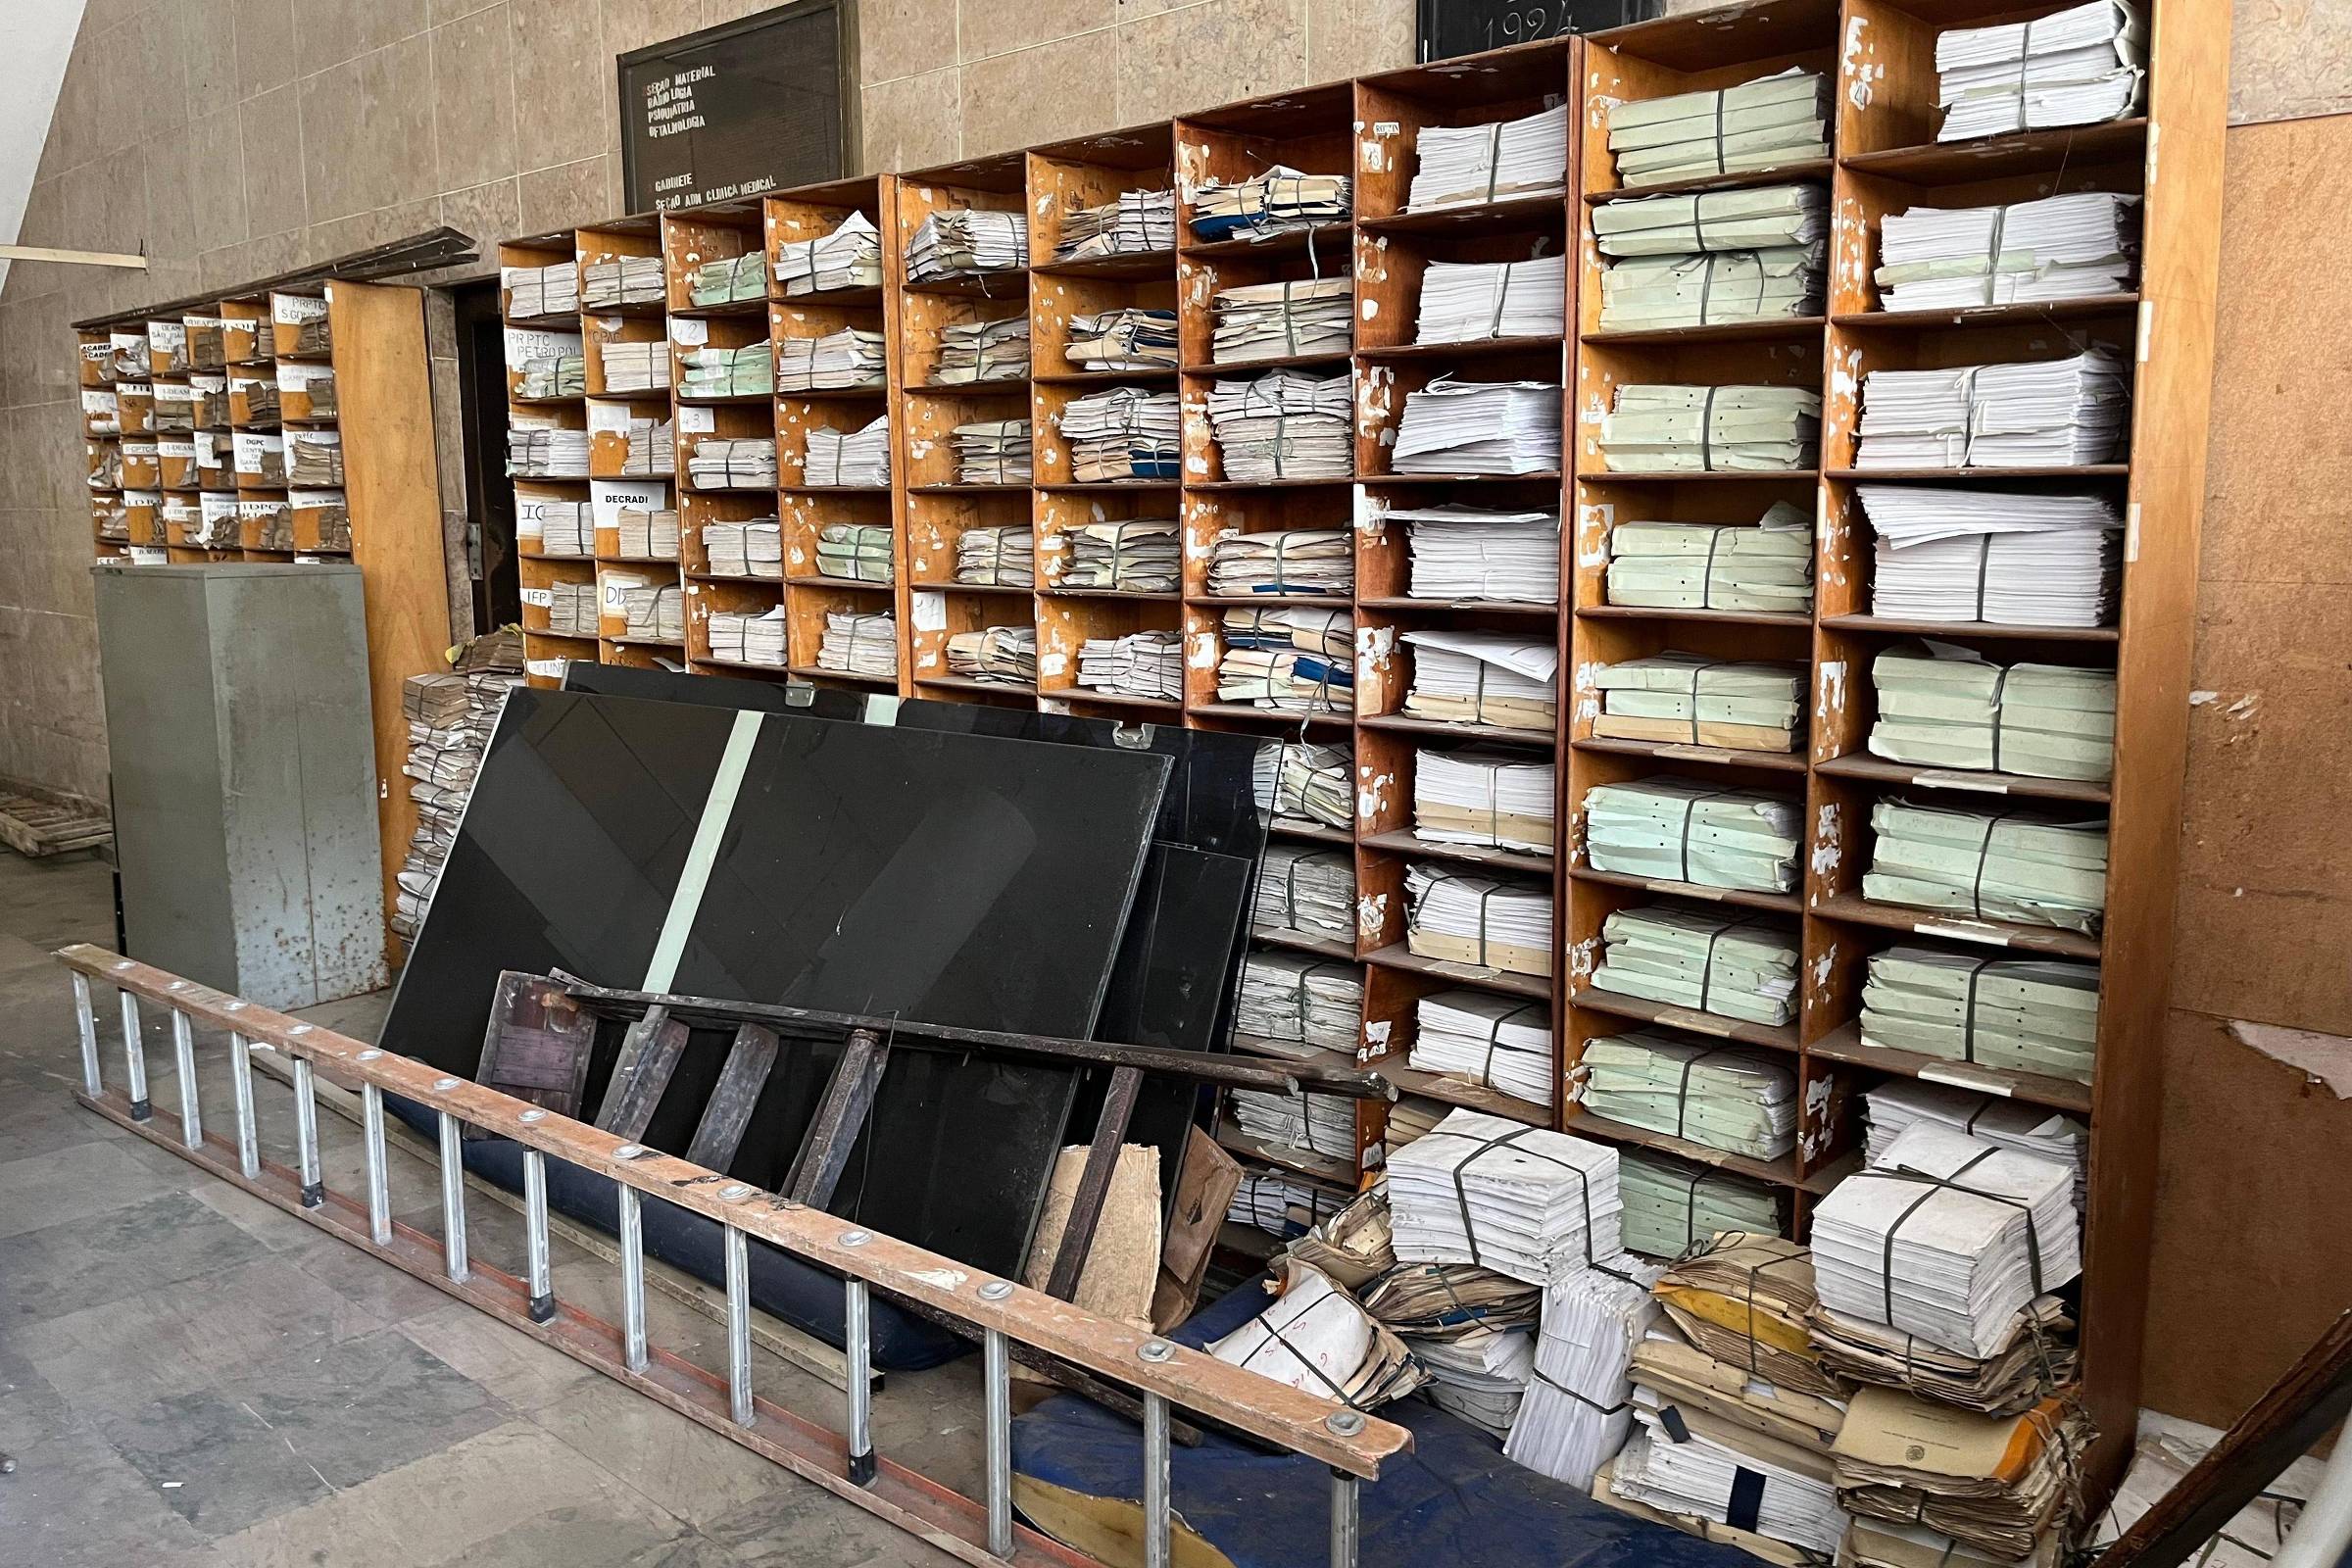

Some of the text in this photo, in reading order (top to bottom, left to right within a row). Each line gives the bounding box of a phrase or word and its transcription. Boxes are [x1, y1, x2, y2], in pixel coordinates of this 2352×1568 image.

[674, 66, 716, 86] MATERIAL
[655, 172, 693, 192] GABINETE
[740, 174, 777, 196] MEDICAL
[605, 495, 649, 504] DECRADI
[527, 591, 547, 604] IFP
